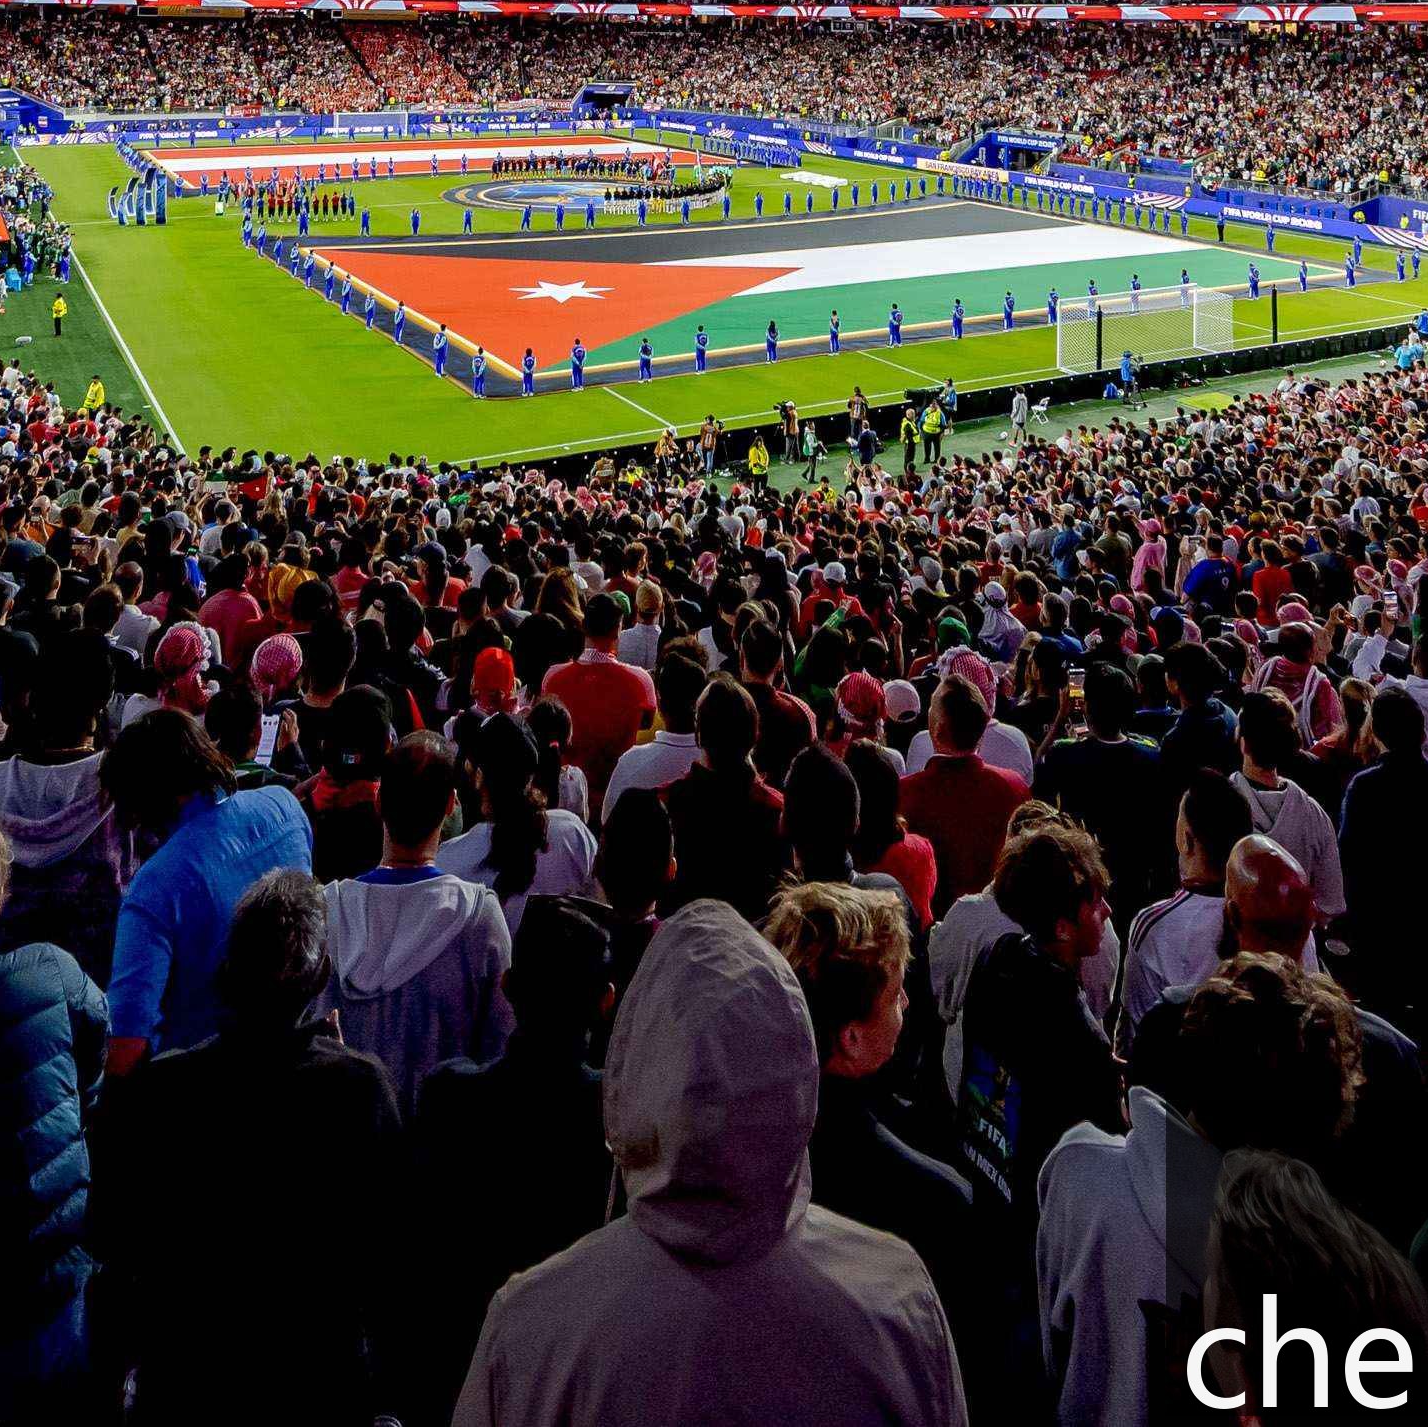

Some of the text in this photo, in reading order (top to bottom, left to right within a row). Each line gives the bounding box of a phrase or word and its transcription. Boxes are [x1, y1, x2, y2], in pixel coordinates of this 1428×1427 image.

[1223, 207, 1323, 230] FIFA WORLD CUP 2026
[979, 1117, 1007, 1159] FIFA
